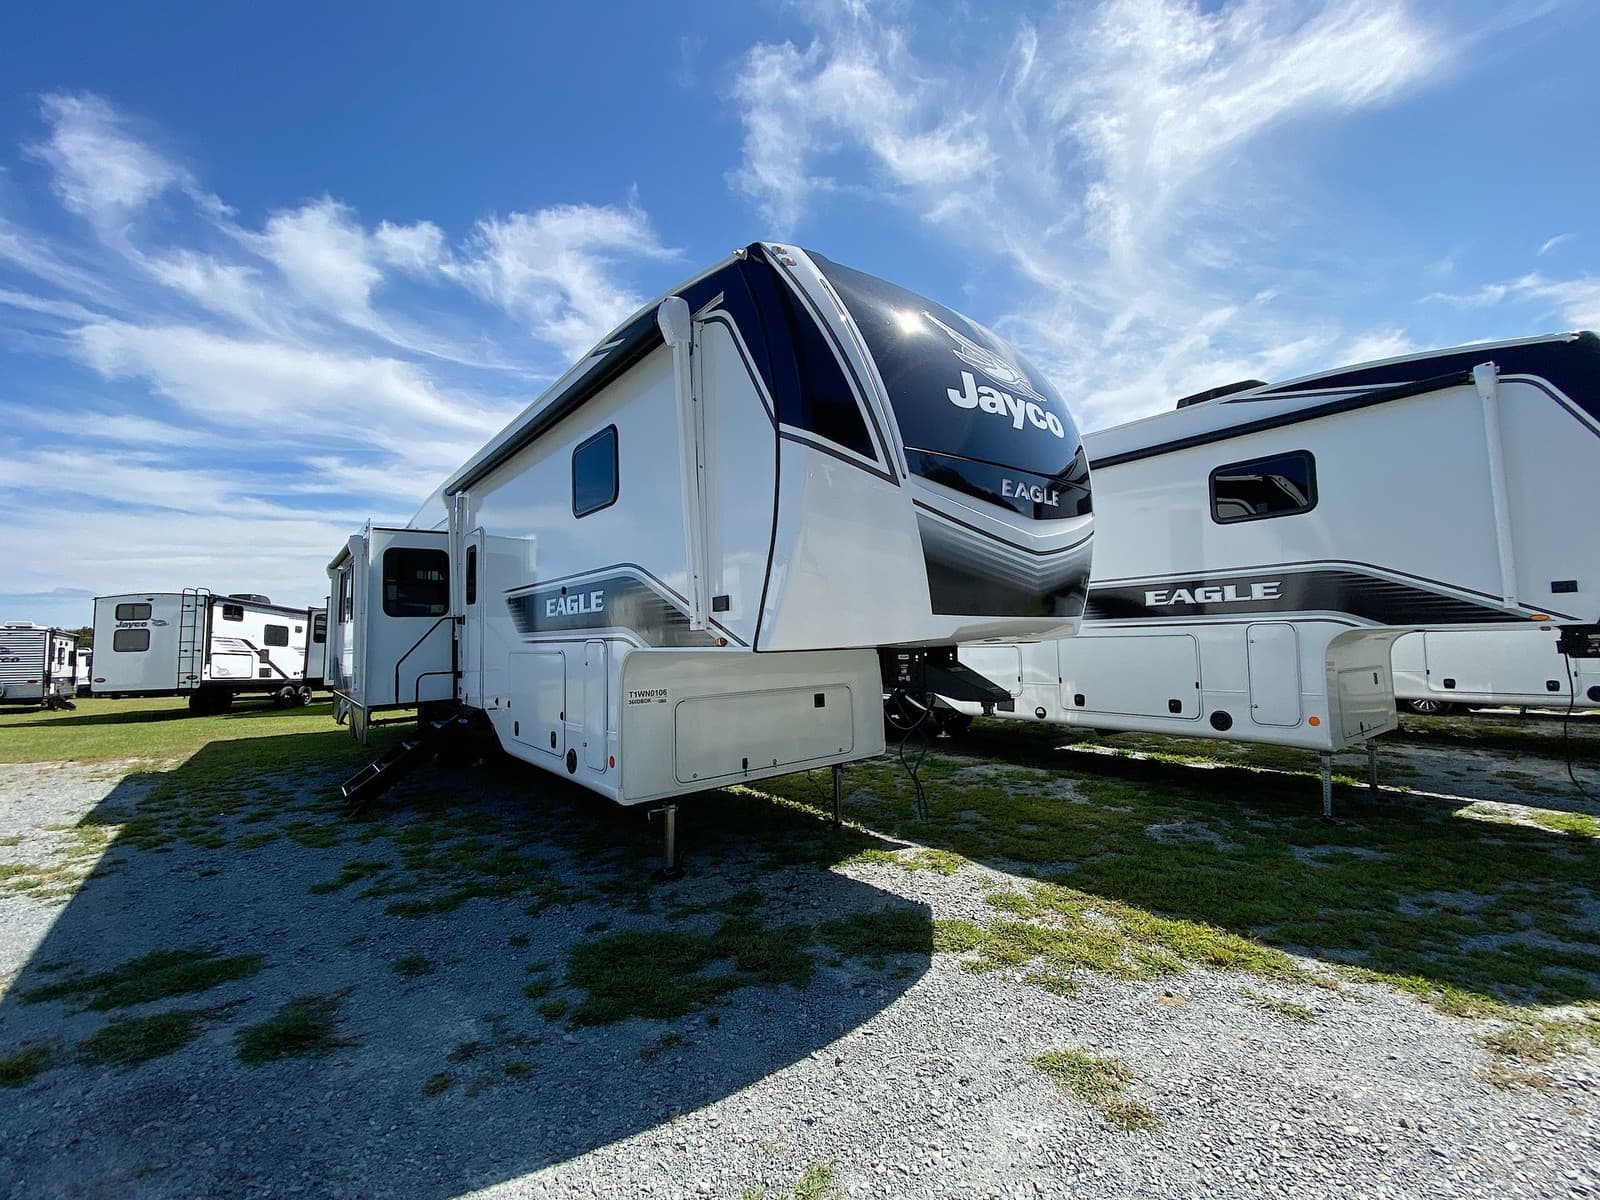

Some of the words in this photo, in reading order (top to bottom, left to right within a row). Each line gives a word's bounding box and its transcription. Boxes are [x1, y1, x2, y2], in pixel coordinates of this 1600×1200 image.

[946, 370, 1065, 439] Jayco
[1001, 478, 1060, 508] EAGLE
[545, 590, 605, 617] EAGLE
[1144, 581, 1283, 607] EAGLE
